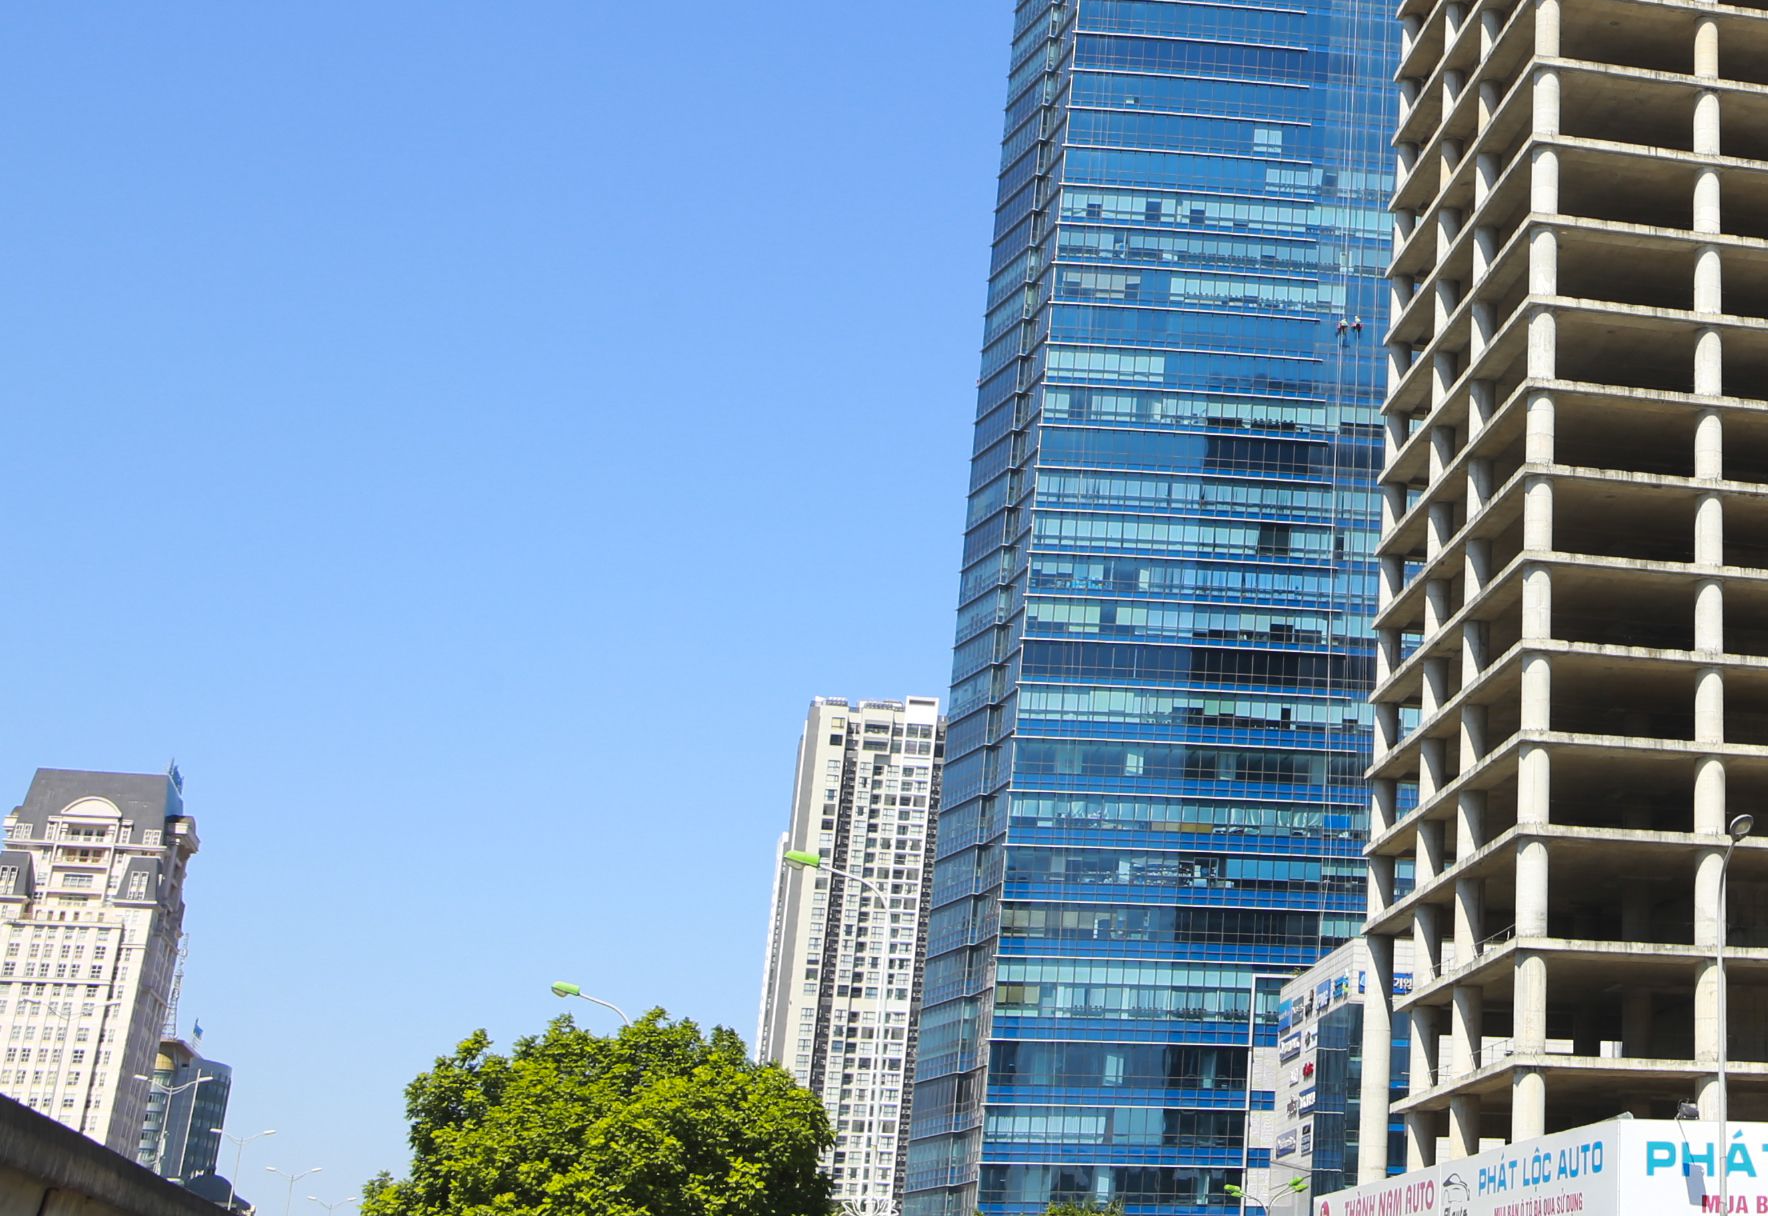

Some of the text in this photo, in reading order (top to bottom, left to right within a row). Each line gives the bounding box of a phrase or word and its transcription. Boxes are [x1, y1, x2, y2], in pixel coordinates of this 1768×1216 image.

[1478, 1140, 1604, 1196] PHÁT LỘC AUTO
[1379, 1187, 1402, 1216] NAM
[1405, 1179, 1434, 1212] AUTO
[1701, 1195, 1748, 1215] MUA
